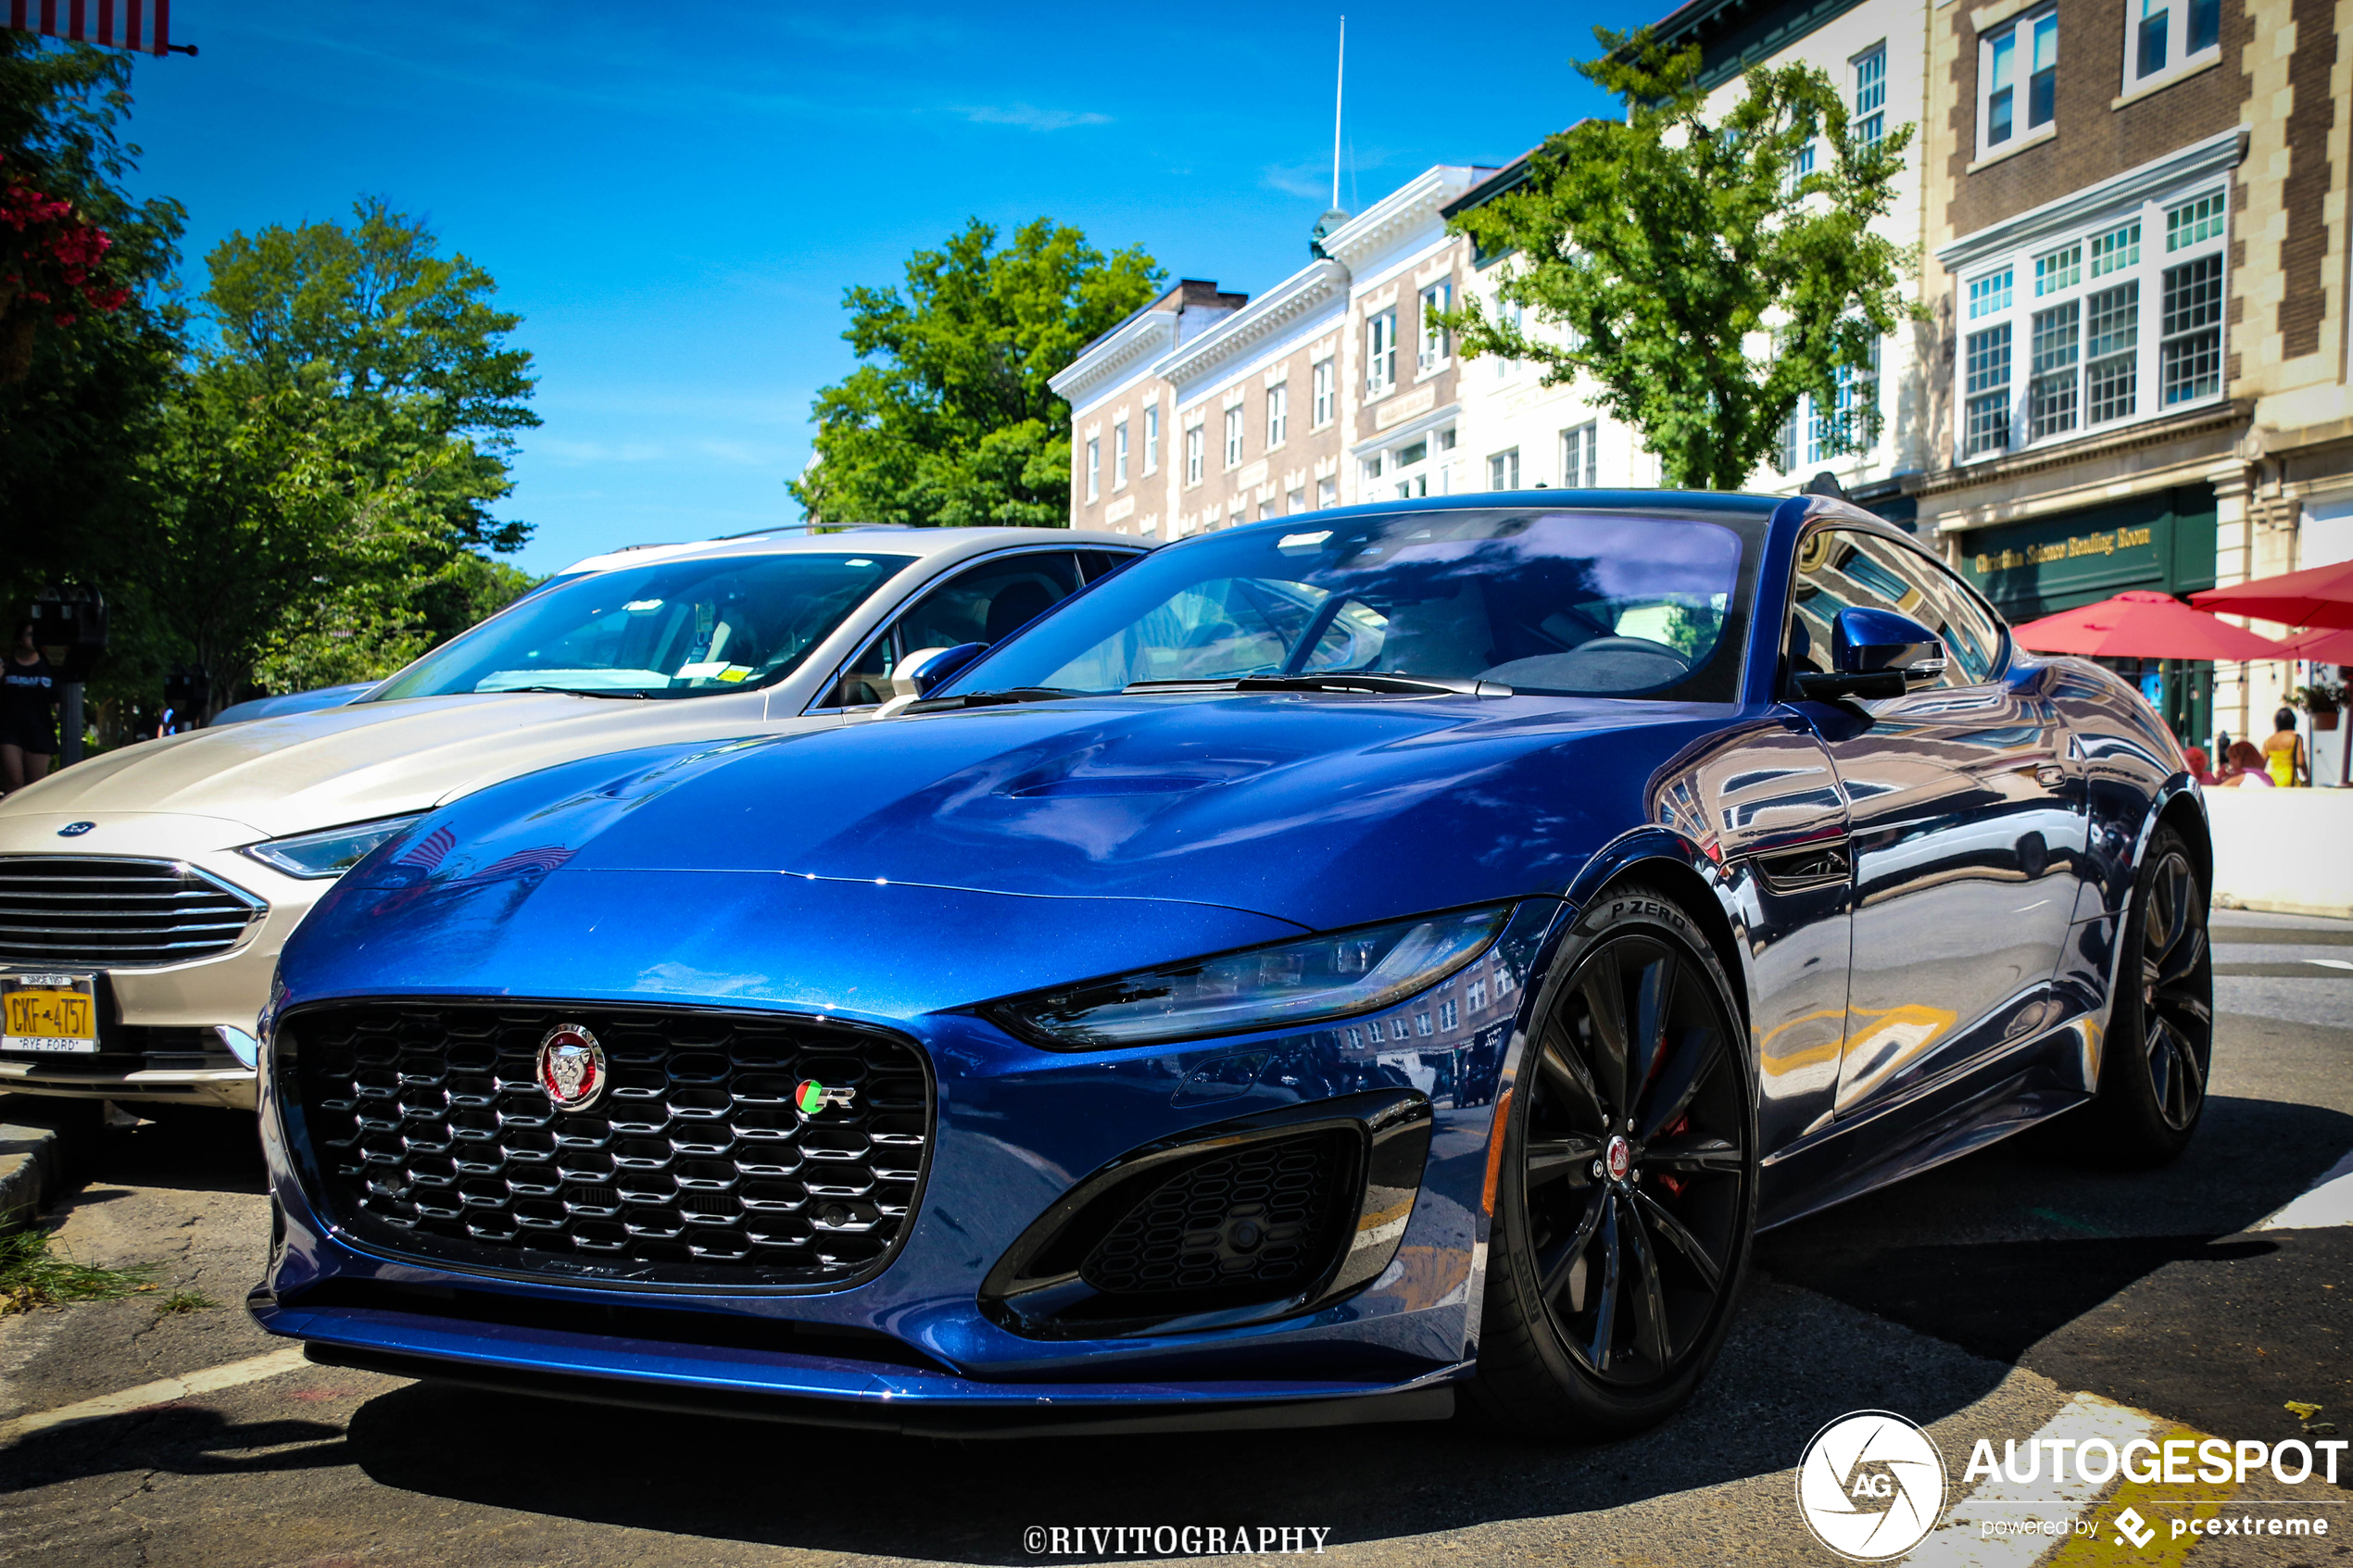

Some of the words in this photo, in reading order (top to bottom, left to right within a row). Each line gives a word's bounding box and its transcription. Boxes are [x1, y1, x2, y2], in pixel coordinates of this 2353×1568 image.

[1976, 548, 2024, 573] Christian
[2027, 543, 2067, 565] Science
[2068, 532, 2115, 556] Reading
[2117, 527, 2150, 548] Room
